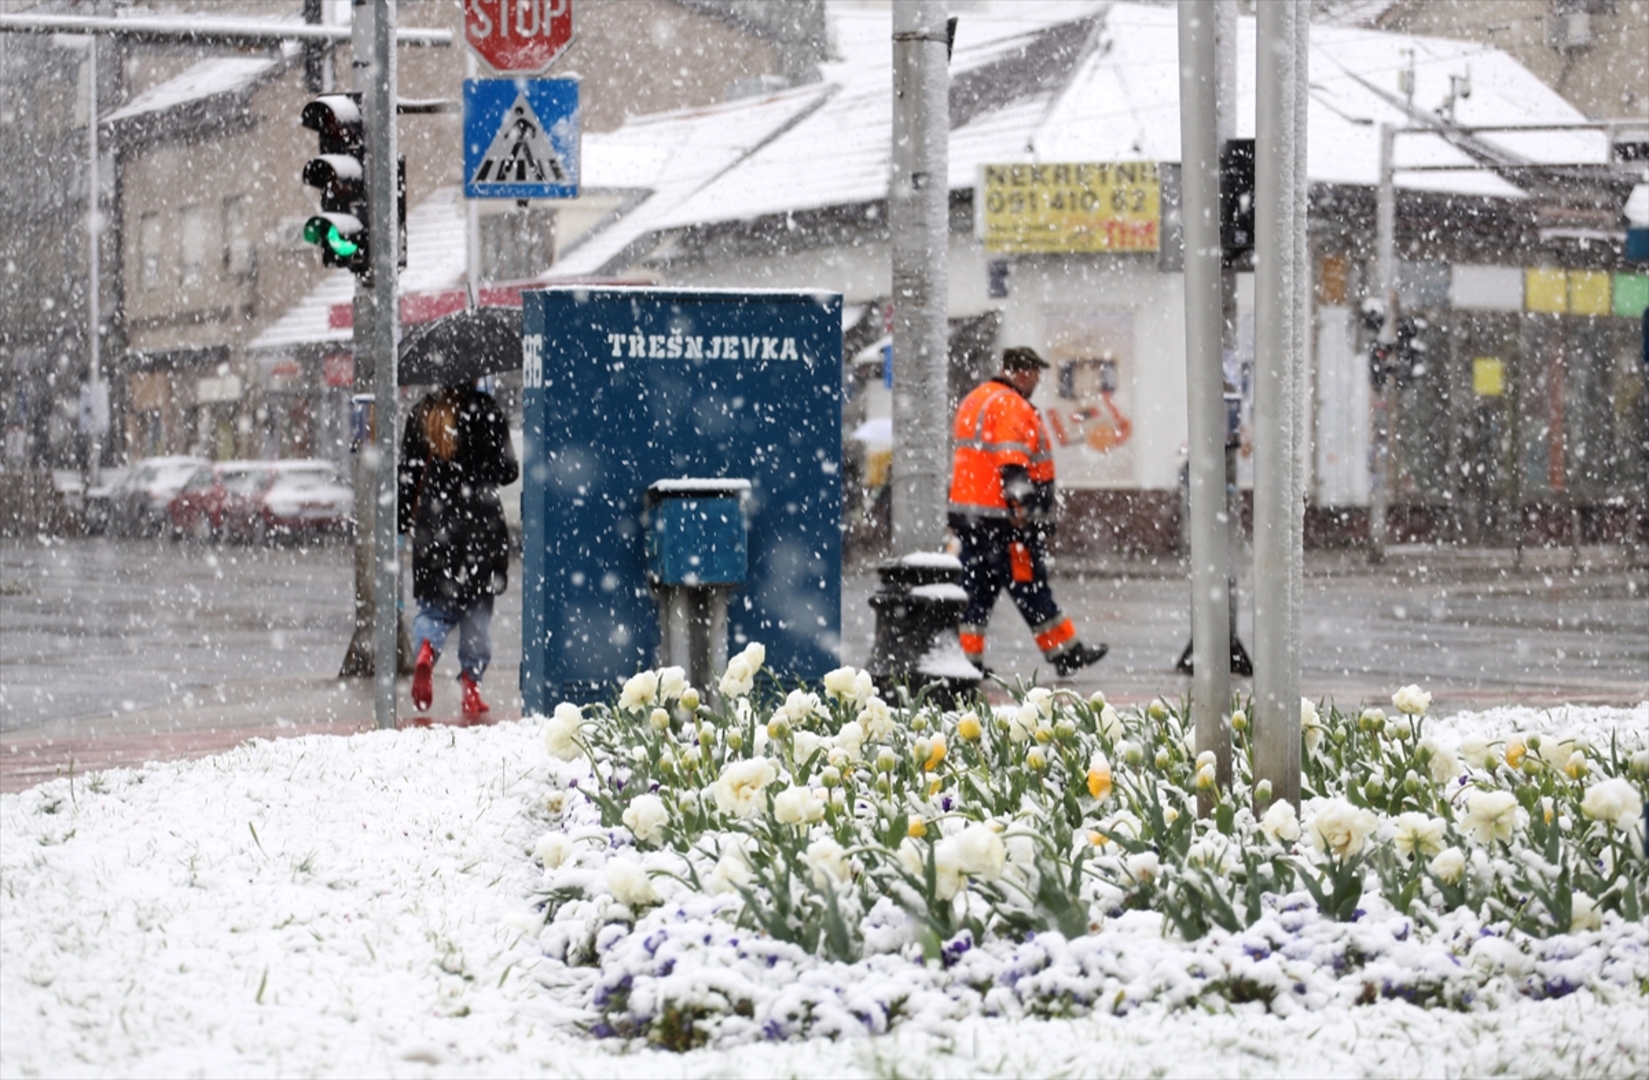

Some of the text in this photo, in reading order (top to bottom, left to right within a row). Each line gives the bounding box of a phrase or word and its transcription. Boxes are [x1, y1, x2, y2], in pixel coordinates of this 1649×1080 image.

[470, 0, 568, 39] STOP
[1050, 189, 1099, 213] 410
[607, 327, 799, 361] TREŠNJEVKA
